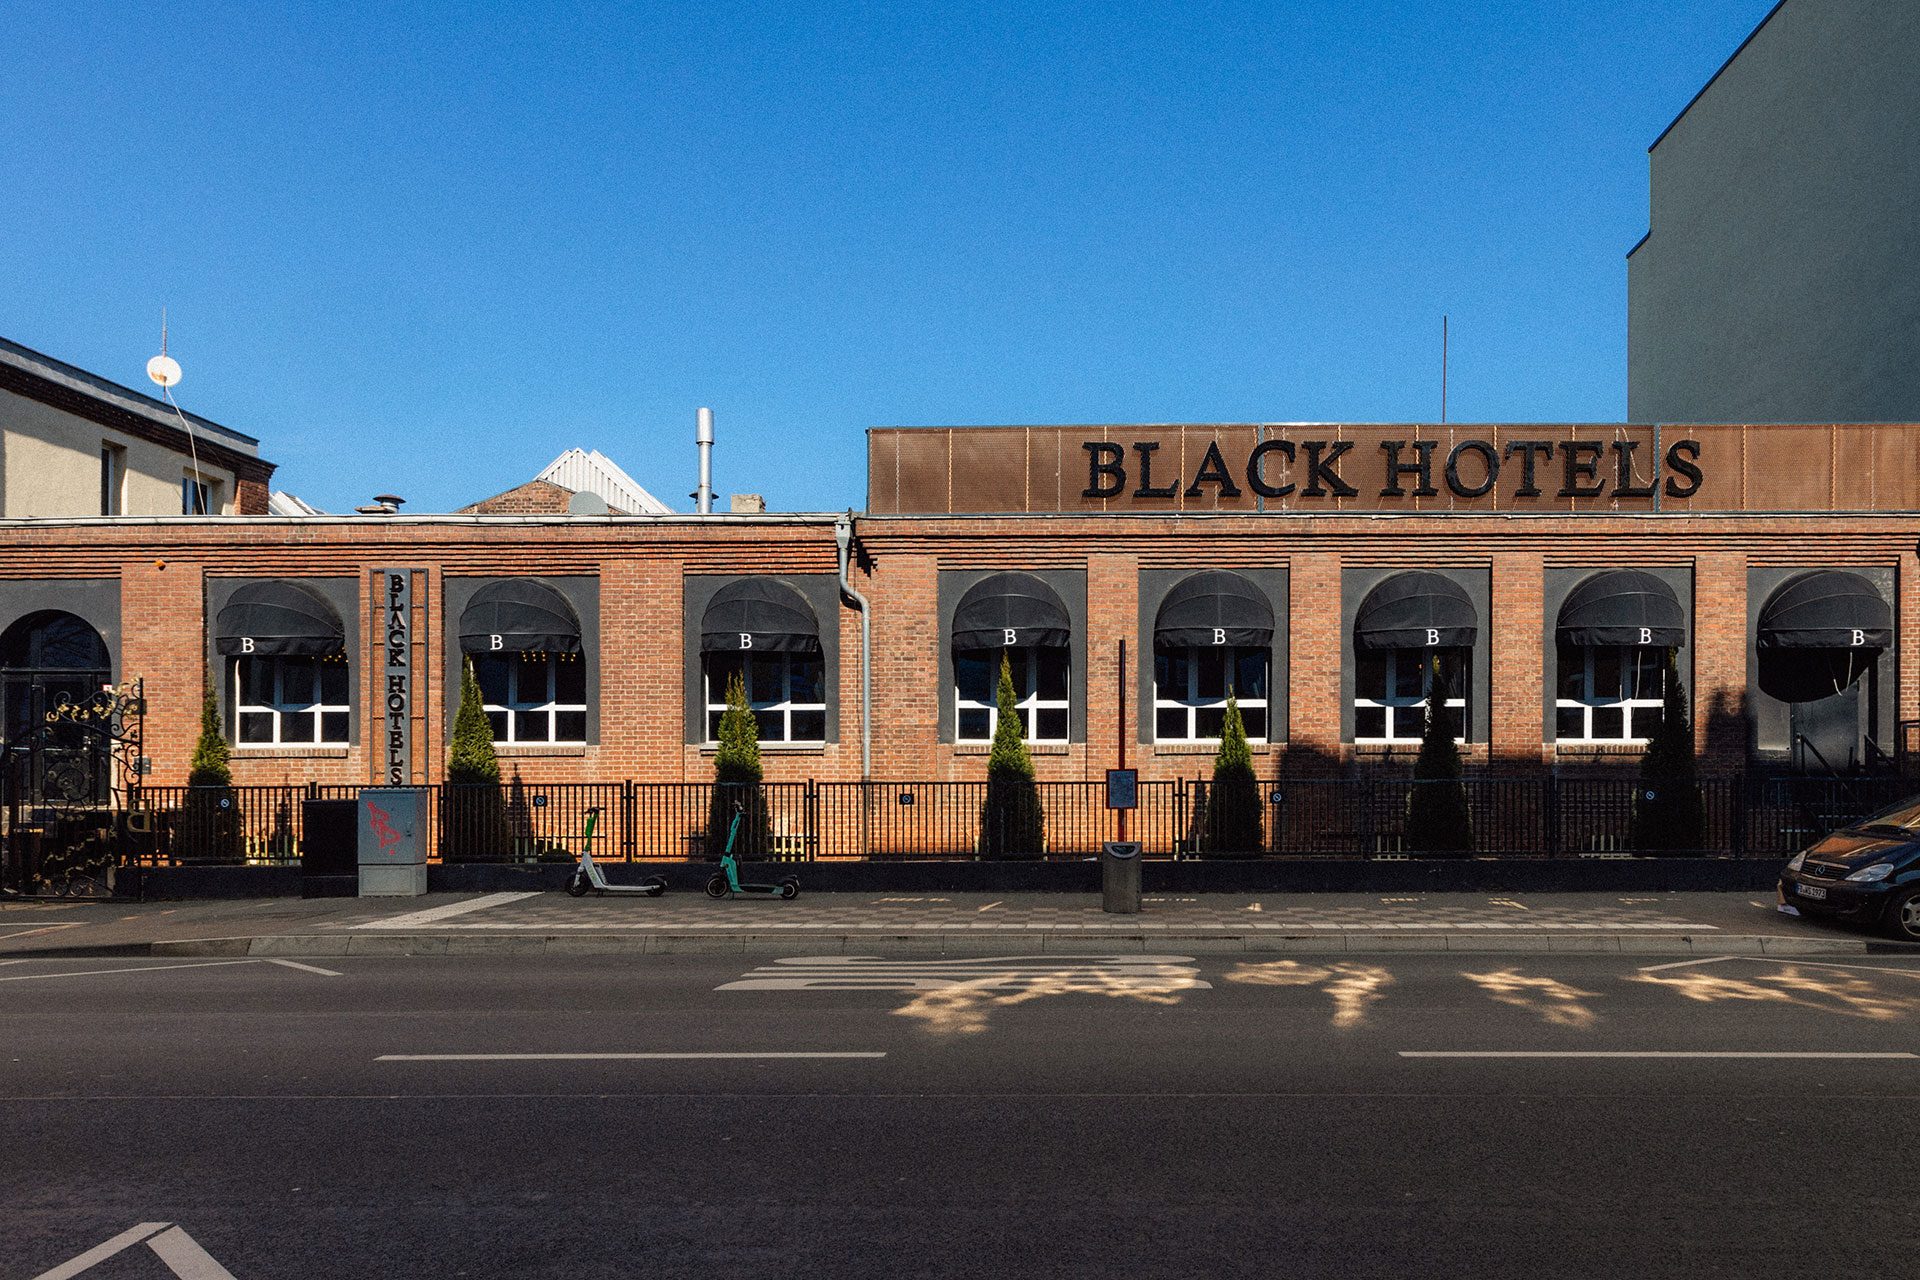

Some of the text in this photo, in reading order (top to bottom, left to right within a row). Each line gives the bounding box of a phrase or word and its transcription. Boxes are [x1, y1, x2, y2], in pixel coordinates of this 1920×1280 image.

[1082, 441, 1703, 497] BLACK HOTELS
[490, 635, 503, 650] B
[739, 633, 752, 649] B
[1003, 629, 1016, 645] B
[1212, 628, 1225, 644] B
[1426, 629, 1439, 645] B
[1638, 628, 1651, 644] B
[1851, 630, 1865, 645] B
[241, 638, 254, 653] B
[388, 574, 406, 785] BLACK HOTELS
[713, 955, 1213, 990] BUS
